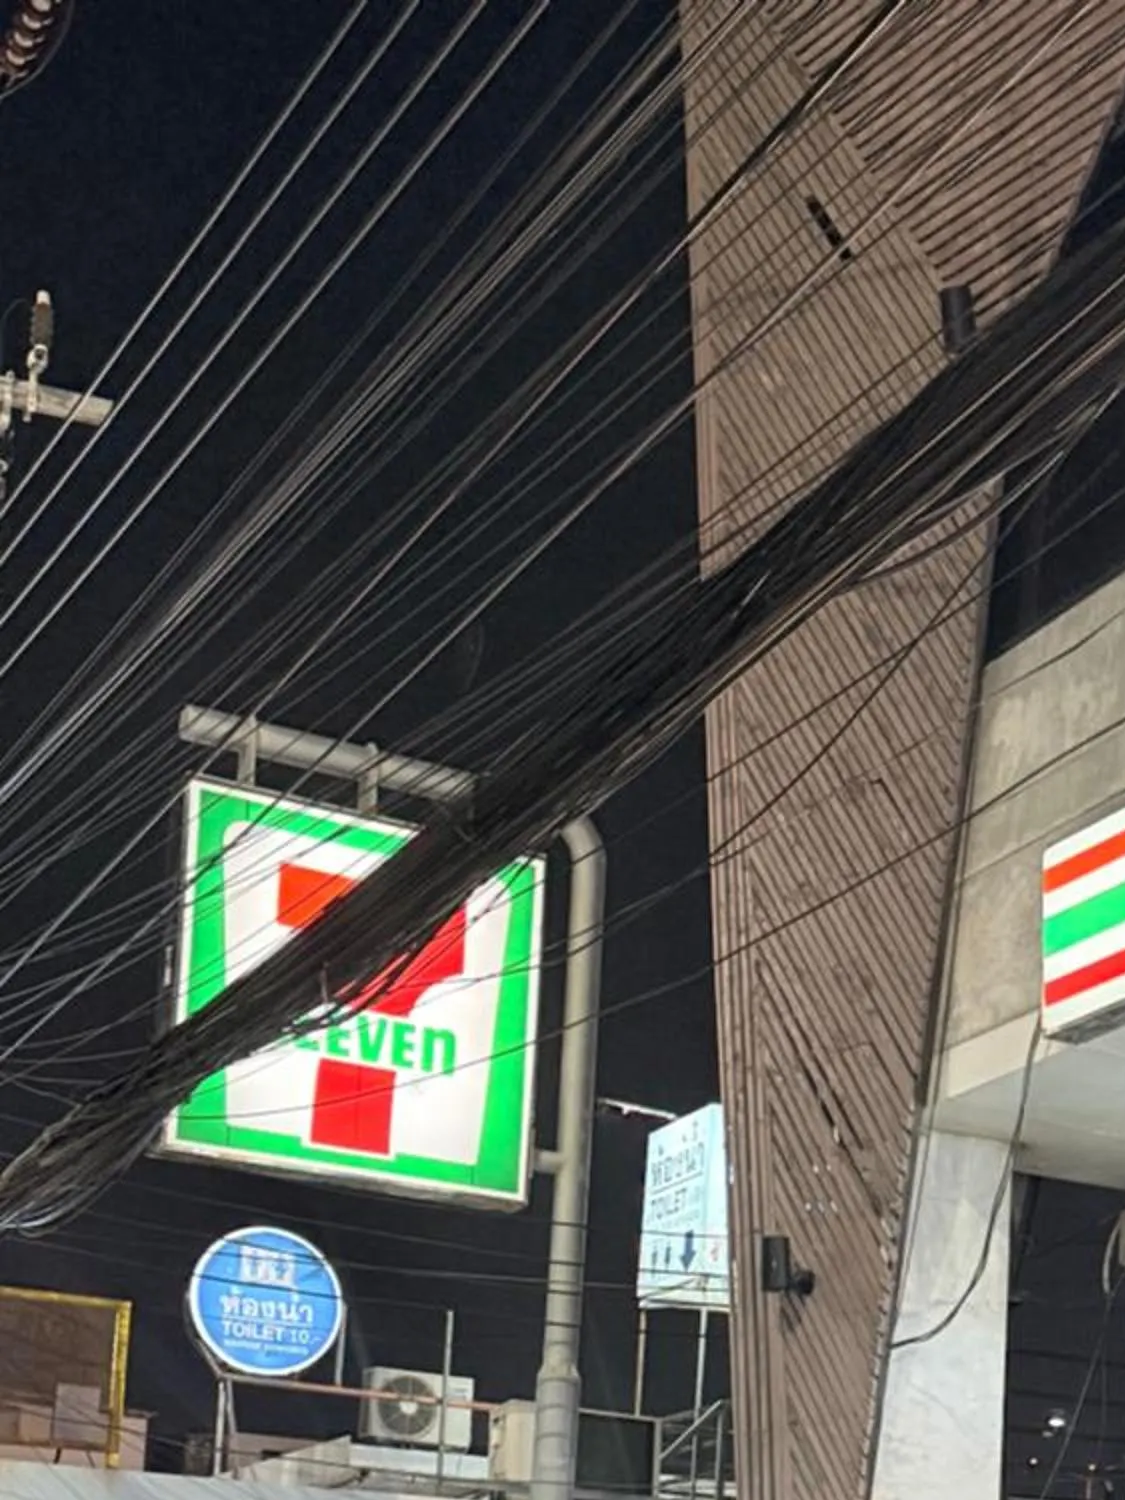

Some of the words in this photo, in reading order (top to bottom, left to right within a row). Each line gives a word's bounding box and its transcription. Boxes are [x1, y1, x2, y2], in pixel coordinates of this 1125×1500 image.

[296, 1014, 457, 1077] EVEn
[219, 1286, 313, 1323] ห้องน้ำ
[223, 1320, 285, 1342] TOILET
